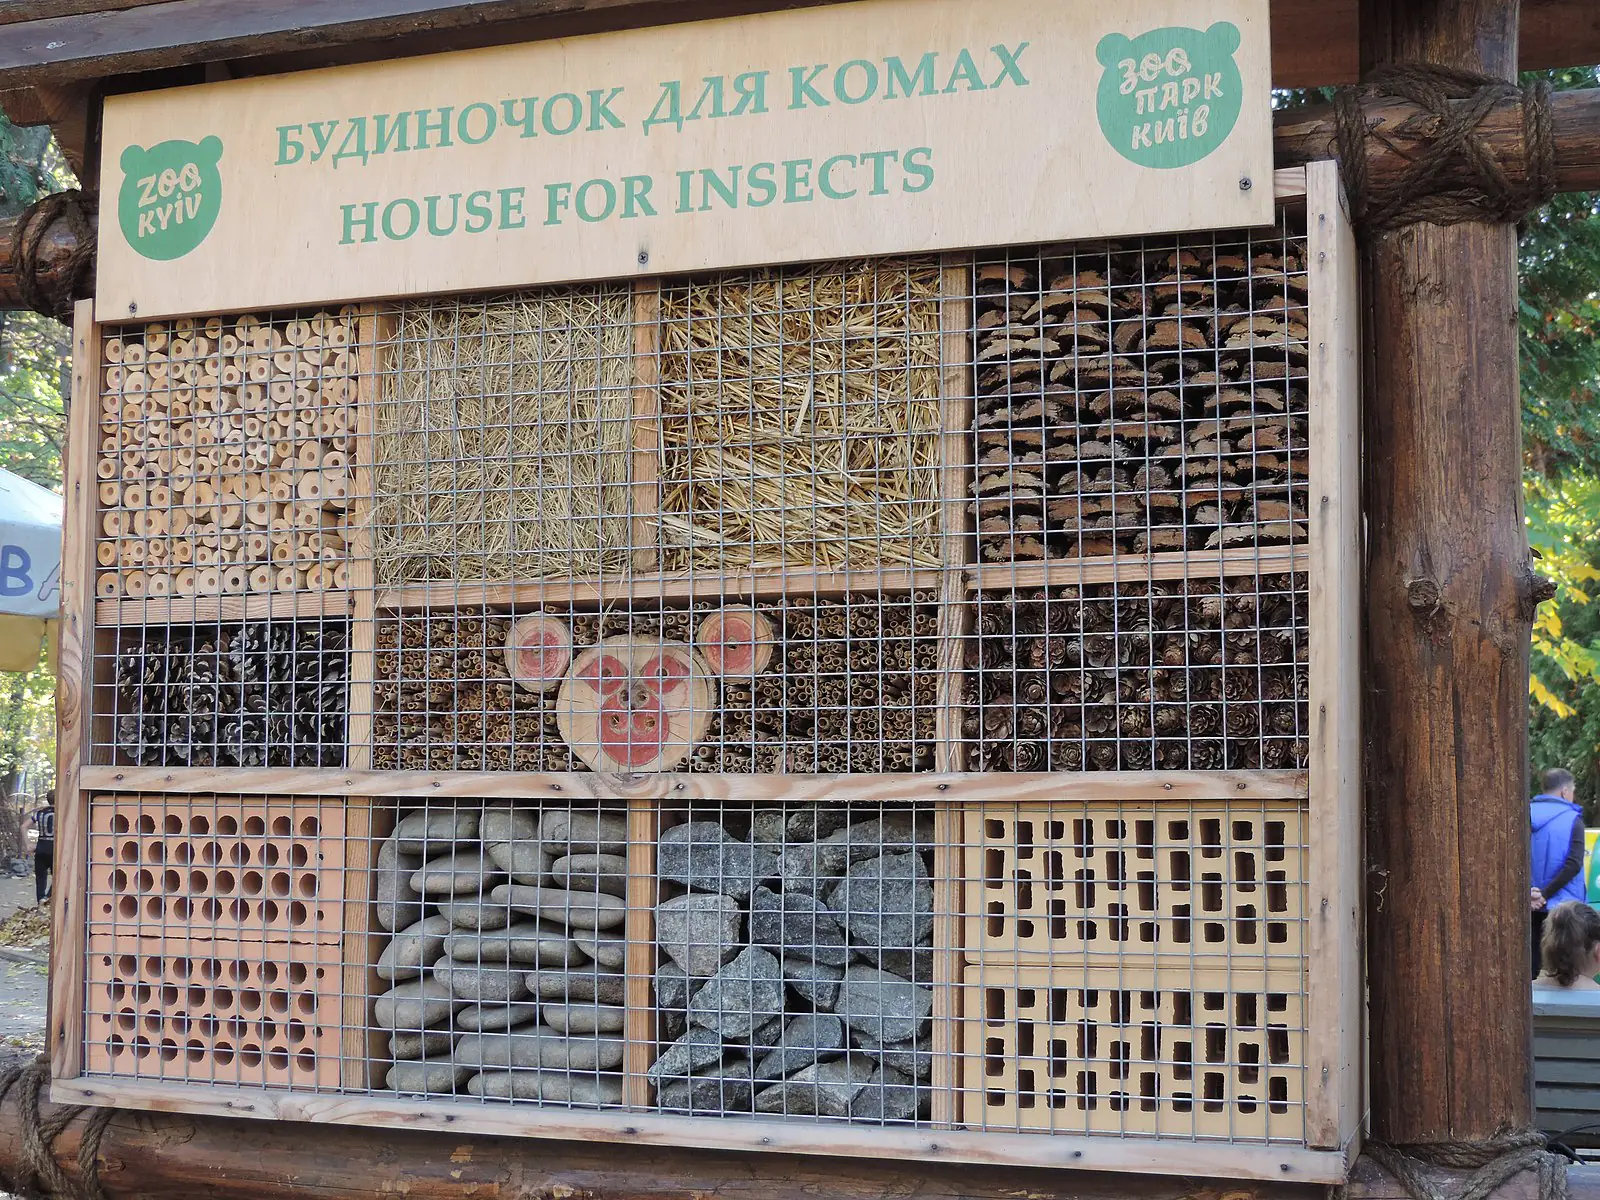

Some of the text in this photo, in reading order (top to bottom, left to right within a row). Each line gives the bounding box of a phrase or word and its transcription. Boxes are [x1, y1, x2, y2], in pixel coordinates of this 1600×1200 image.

[1118, 47, 1192, 95] ЗОО
[1135, 72, 1224, 115] ПАРК
[276, 41, 1031, 170] БУДИНОЧОК ДЛЯ КОМАХ
[136, 162, 202, 208] ZOO
[339, 146, 936, 246] HOUSE FOR INSECTS
